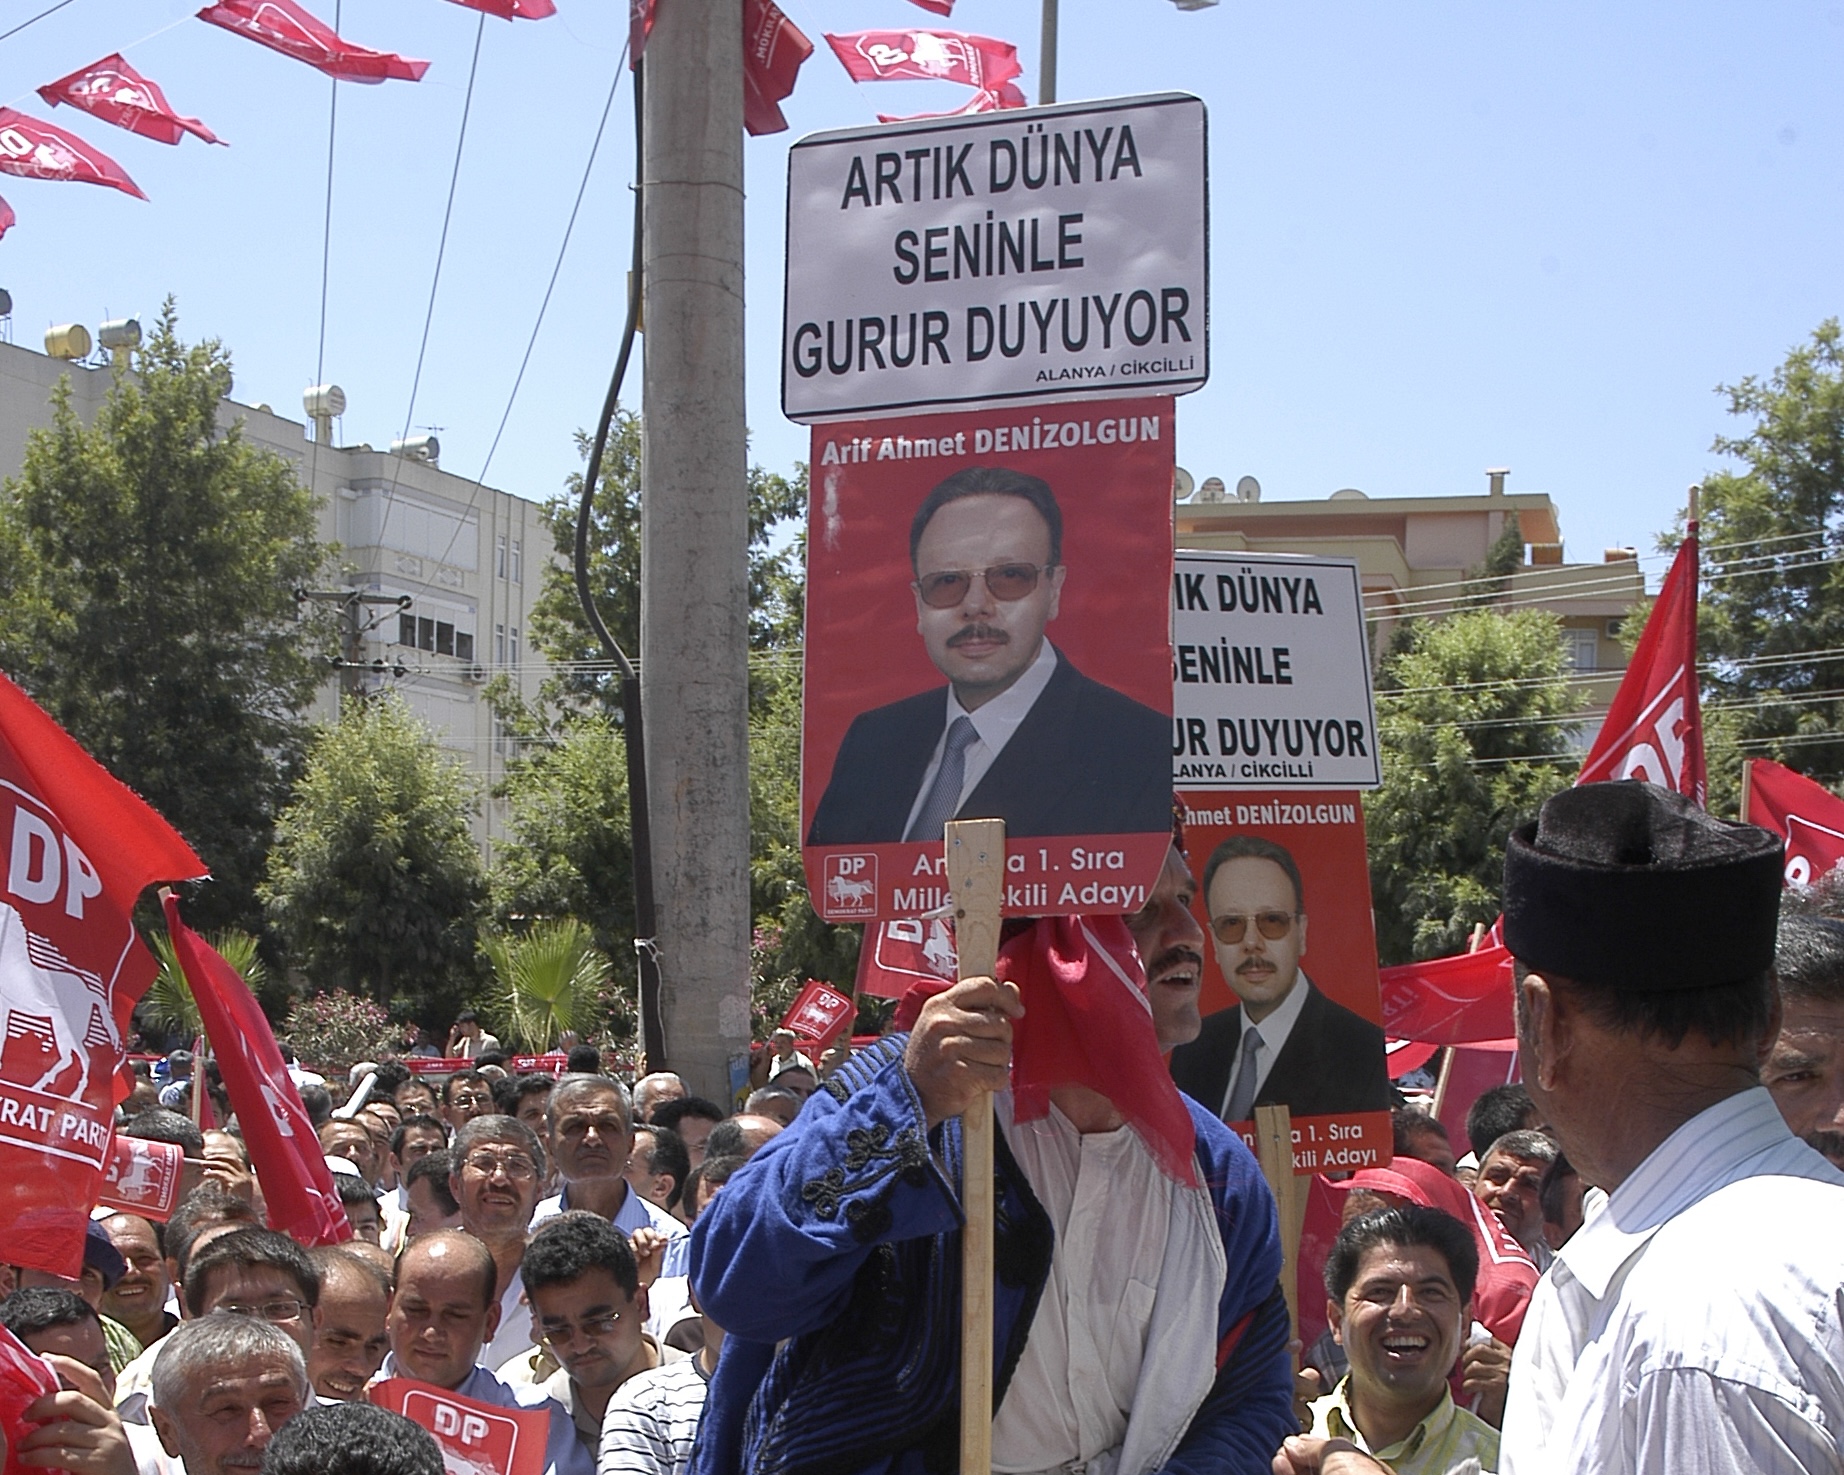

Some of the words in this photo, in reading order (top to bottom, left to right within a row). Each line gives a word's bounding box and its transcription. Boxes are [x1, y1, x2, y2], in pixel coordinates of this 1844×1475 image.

[841, 142, 974, 210] ARTIK
[990, 123, 1143, 193] DÜNYA
[893, 210, 1085, 285] SENİNLE
[793, 310, 951, 378] GURUR
[966, 287, 1192, 362] DUYUYOR
[1036, 364, 1106, 383] ALANYA
[1120, 355, 1195, 376] CİKCİLLİ
[821, 437, 871, 466] Arif
[876, 431, 965, 461] Ahmet
[975, 416, 1160, 454] DENİZOLGUN
[1216, 567, 1324, 615] DÜNYA
[1173, 637, 1293, 685] ENİNLE
[1217, 718, 1368, 757] DUYUYOR
[1241, 760, 1313, 778] CİKCİLLİ
[1185, 805, 1232, 825] hmet
[1236, 799, 1356, 825] DENİZOLGUN
[8, 804, 103, 920] DP
[839, 857, 866, 875] DP
[1039, 849, 1059, 871] 1.
[1070, 847, 1124, 871] Sıra
[1057, 881, 1145, 908] Adayı
[1308, 1125, 1323, 1142] 1.
[1329, 1123, 1363, 1140] Sıra
[1323, 1148, 1377, 1166] Adayı
[433, 1402, 489, 1446] DP
